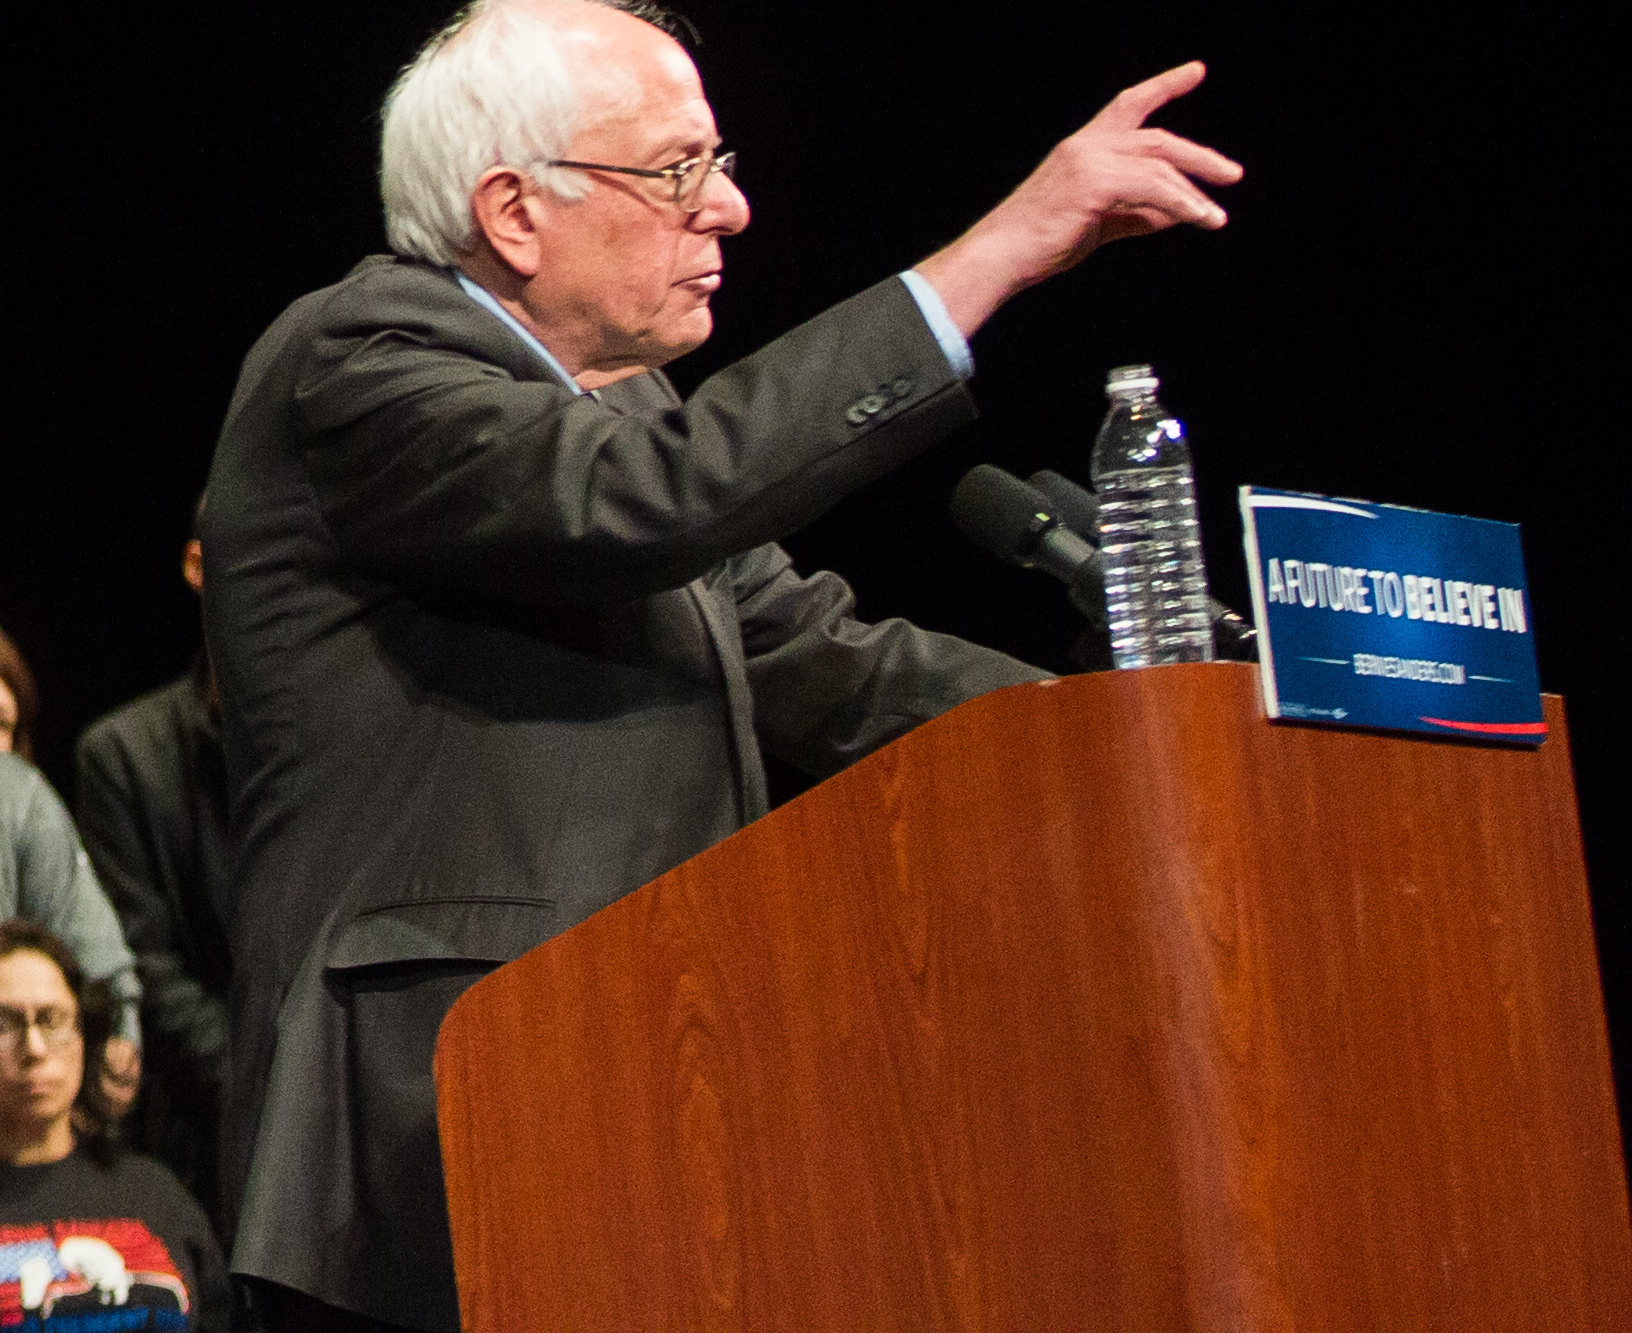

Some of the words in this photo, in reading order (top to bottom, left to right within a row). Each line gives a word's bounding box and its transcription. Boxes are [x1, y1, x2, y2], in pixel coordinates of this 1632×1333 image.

[1268, 557, 1288, 604] A
[1283, 559, 1373, 615] FUTURE
[1368, 570, 1404, 619] TO
[1402, 574, 1499, 630] BELIEVE
[1497, 587, 1527, 634] IN
